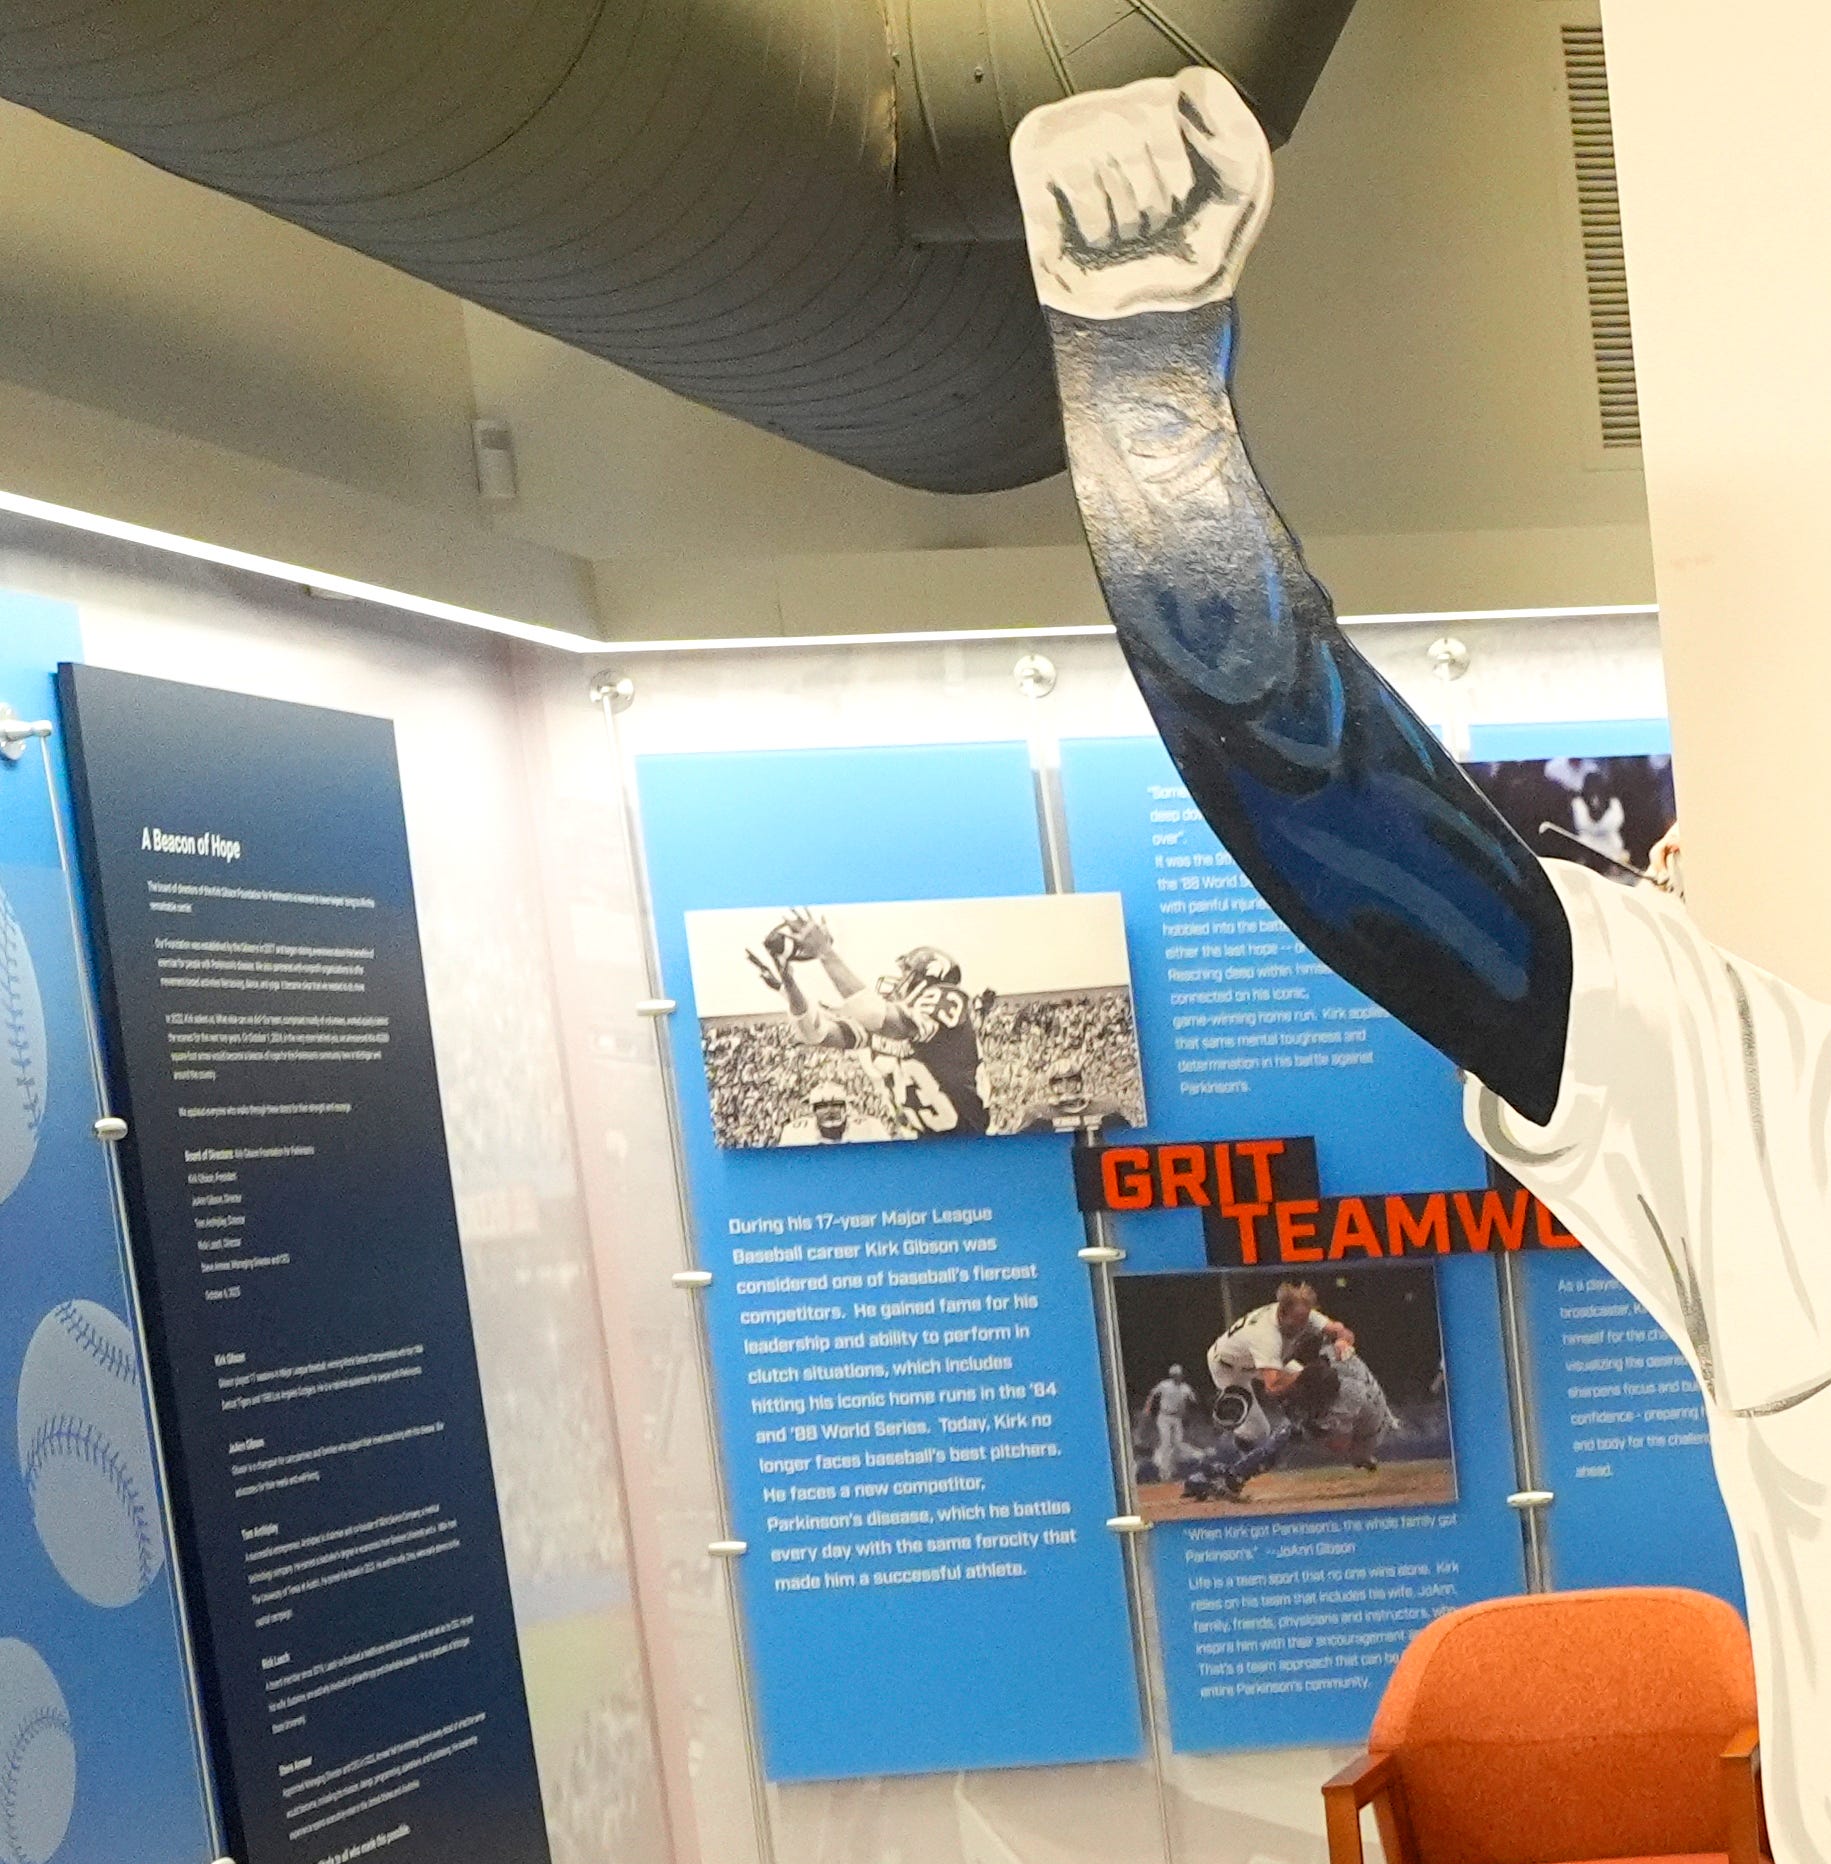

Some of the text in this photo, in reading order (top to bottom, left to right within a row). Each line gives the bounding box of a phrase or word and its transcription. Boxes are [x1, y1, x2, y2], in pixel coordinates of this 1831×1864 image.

[141, 826, 241, 862] A Beacon of Hope
[1100, 1140, 1285, 1211] GRIT
[727, 1208, 993, 1234] During his 17-year Major League
[1222, 1189, 1583, 1264] TEAMW
[731, 1237, 997, 1264] Baseball career Kirk Gibson was
[735, 1264, 1037, 1294] considered one of baseball's fiercest
[852, 1303, 878, 1317] He
[878, 1299, 937, 1319] gained
[938, 1297, 982, 1313] fame
[984, 1295, 1009, 1310] for
[1012, 1293, 1038, 1308] his
[743, 1324, 1030, 1354] leadership and ability to perform in
[746, 1355, 1013, 1384] clutch situations, which includes
[749, 1396, 808, 1414] hitting
[806, 1394, 835, 1410] his
[835, 1392, 886, 1408] iconic
[887, 1390, 936, 1405] home
[937, 1388, 977, 1402] runs
[978, 1386, 995, 1400] in
[997, 1384, 1026, 1399] the
[754, 1426, 790, 1443] and
[819, 1421, 873, 1439] World
[940, 1416, 990, 1432] Today,
[993, 1412, 1028, 1429] Kirk
[1030, 1413, 1052, 1427] no
[758, 1457, 811, 1474] longer
[814, 1453, 862, 1469] faces
[863, 1447, 947, 1466] baseball's
[948, 1445, 987, 1461] best
[762, 1487, 787, 1502] He
[788, 1485, 837, 1500] faces
[838, 1484, 852, 1498] a
[853, 1482, 890, 1497] new
[766, 1500, 1071, 1531] Parkinson's disease, which he battles
[769, 1529, 1077, 1561] every day with the same ferocity that
[773, 1573, 822, 1590] made
[822, 1572, 856, 1587] him
[858, 1572, 871, 1586] a
[872, 1565, 962, 1584] successful
